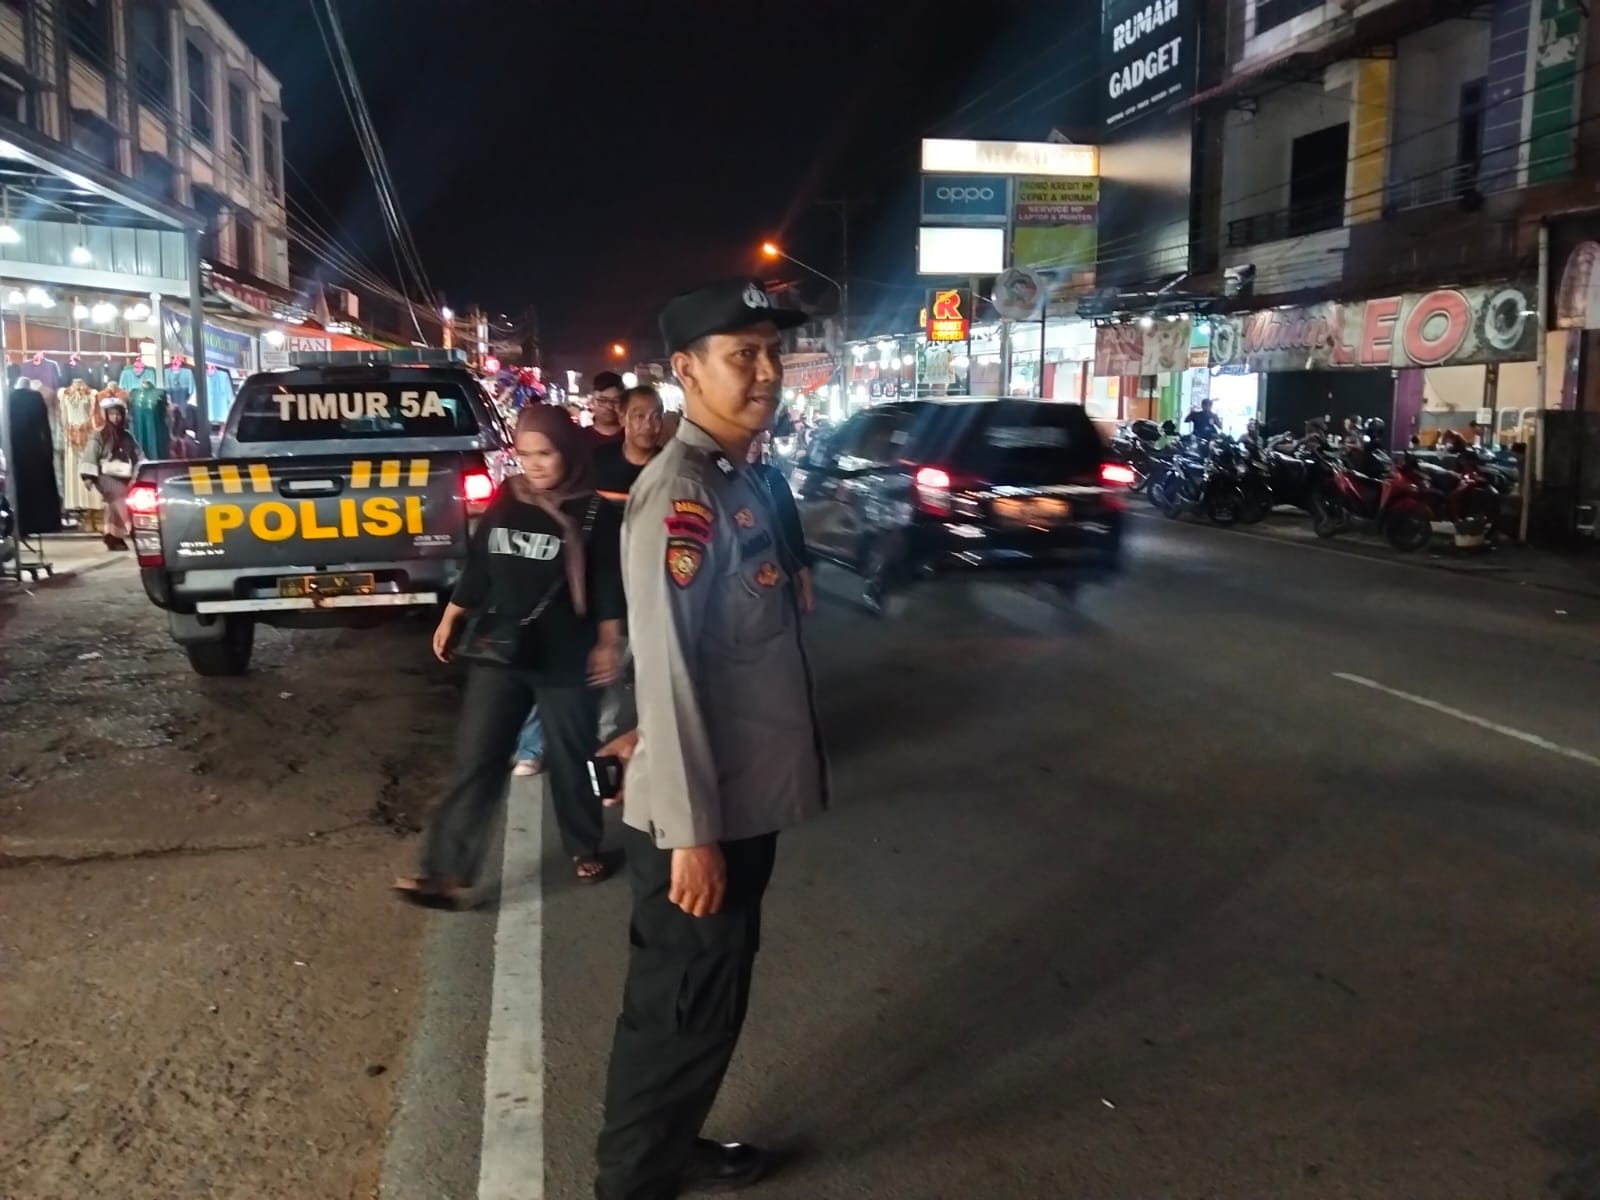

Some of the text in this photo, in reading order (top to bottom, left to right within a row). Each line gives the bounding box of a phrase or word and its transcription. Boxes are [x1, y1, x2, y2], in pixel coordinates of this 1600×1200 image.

[1113, 0, 1178, 53] RUMAH
[1109, 36, 1182, 99] GADGET
[936, 187, 994, 204] oppo
[1050, 181, 1080, 191] KREDIT
[1328, 289, 1472, 366] LEO
[272, 390, 446, 421] TIMUR 5A
[204, 496, 423, 543] POLISI
